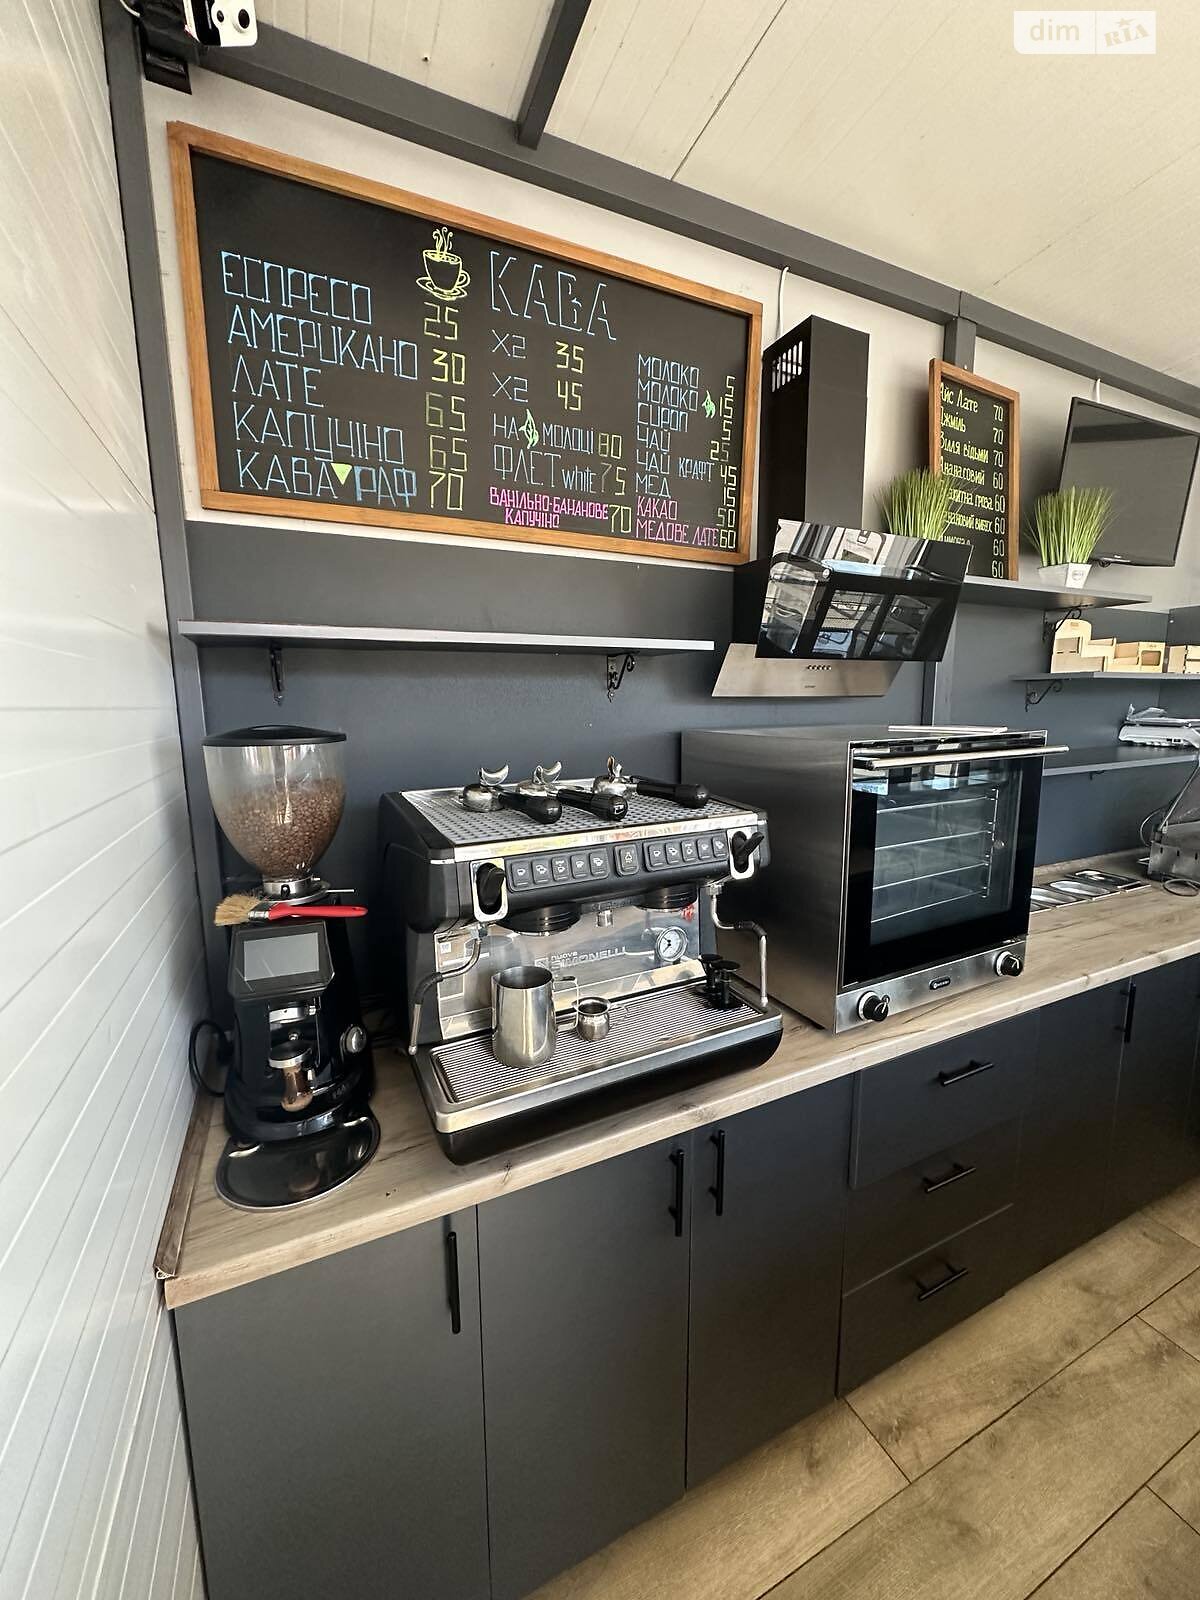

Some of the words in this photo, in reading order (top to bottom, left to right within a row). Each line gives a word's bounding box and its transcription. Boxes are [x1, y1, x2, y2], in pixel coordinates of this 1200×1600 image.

[221, 251, 372, 324] ЕСПРЕСО
[424, 302, 459, 340] 25
[556, 340, 584, 373] 35
[490, 251, 617, 340] КАВА
[228, 304, 418, 380] АМЕРИКАНО
[431, 349, 466, 385] 30
[557, 380, 583, 410] 45
[637, 353, 700, 389] МОЛОКО
[725, 375, 736, 397] 5
[232, 354, 324, 408] ЛАТЕ
[425, 391, 466, 432] 65
[637, 378, 699, 412] МОЛОКО
[719, 397, 734, 419] 15
[956, 389, 979, 413] Лате
[993, 404, 1004, 422] 70
[233, 401, 404, 464] КАПУЧІНО
[429, 435, 467, 472] 65
[493, 412, 519, 441] НА
[598, 432, 622, 459] 80
[637, 402, 688, 433] СИРОП
[721, 420, 733, 441] 5
[992, 427, 1004, 445] 70
[637, 424, 671, 452] ЧАЙ
[710, 440, 730, 462] 25
[993, 449, 1004, 468] 70
[237, 449, 338, 499] КАВА
[354, 465, 417, 508] РАФ
[429, 470, 463, 511] 70
[494, 444, 562, 488] ФЛЕТ
[600, 462, 627, 496] 75
[636, 449, 670, 475] ЧАЙ
[679, 457, 715, 482] КРАФТ
[720, 464, 737, 487] 45
[993, 471, 1004, 490] 60
[636, 472, 671, 499] МЕД
[723, 486, 736, 507] 15
[994, 494, 1005, 513] 60
[505, 507, 560, 529] КАПУЧІНО
[609, 504, 632, 533] 70
[637, 495, 678, 521] КАКАО
[716, 507, 736, 528] 50
[994, 517, 1005, 535] 60
[636, 518, 689, 544] МЕДОВЕ
[692, 526, 719, 547] ЛАТЕ
[719, 529, 736, 550] 60
[993, 538, 1004, 557] 60
[992, 560, 1004, 579] 60
